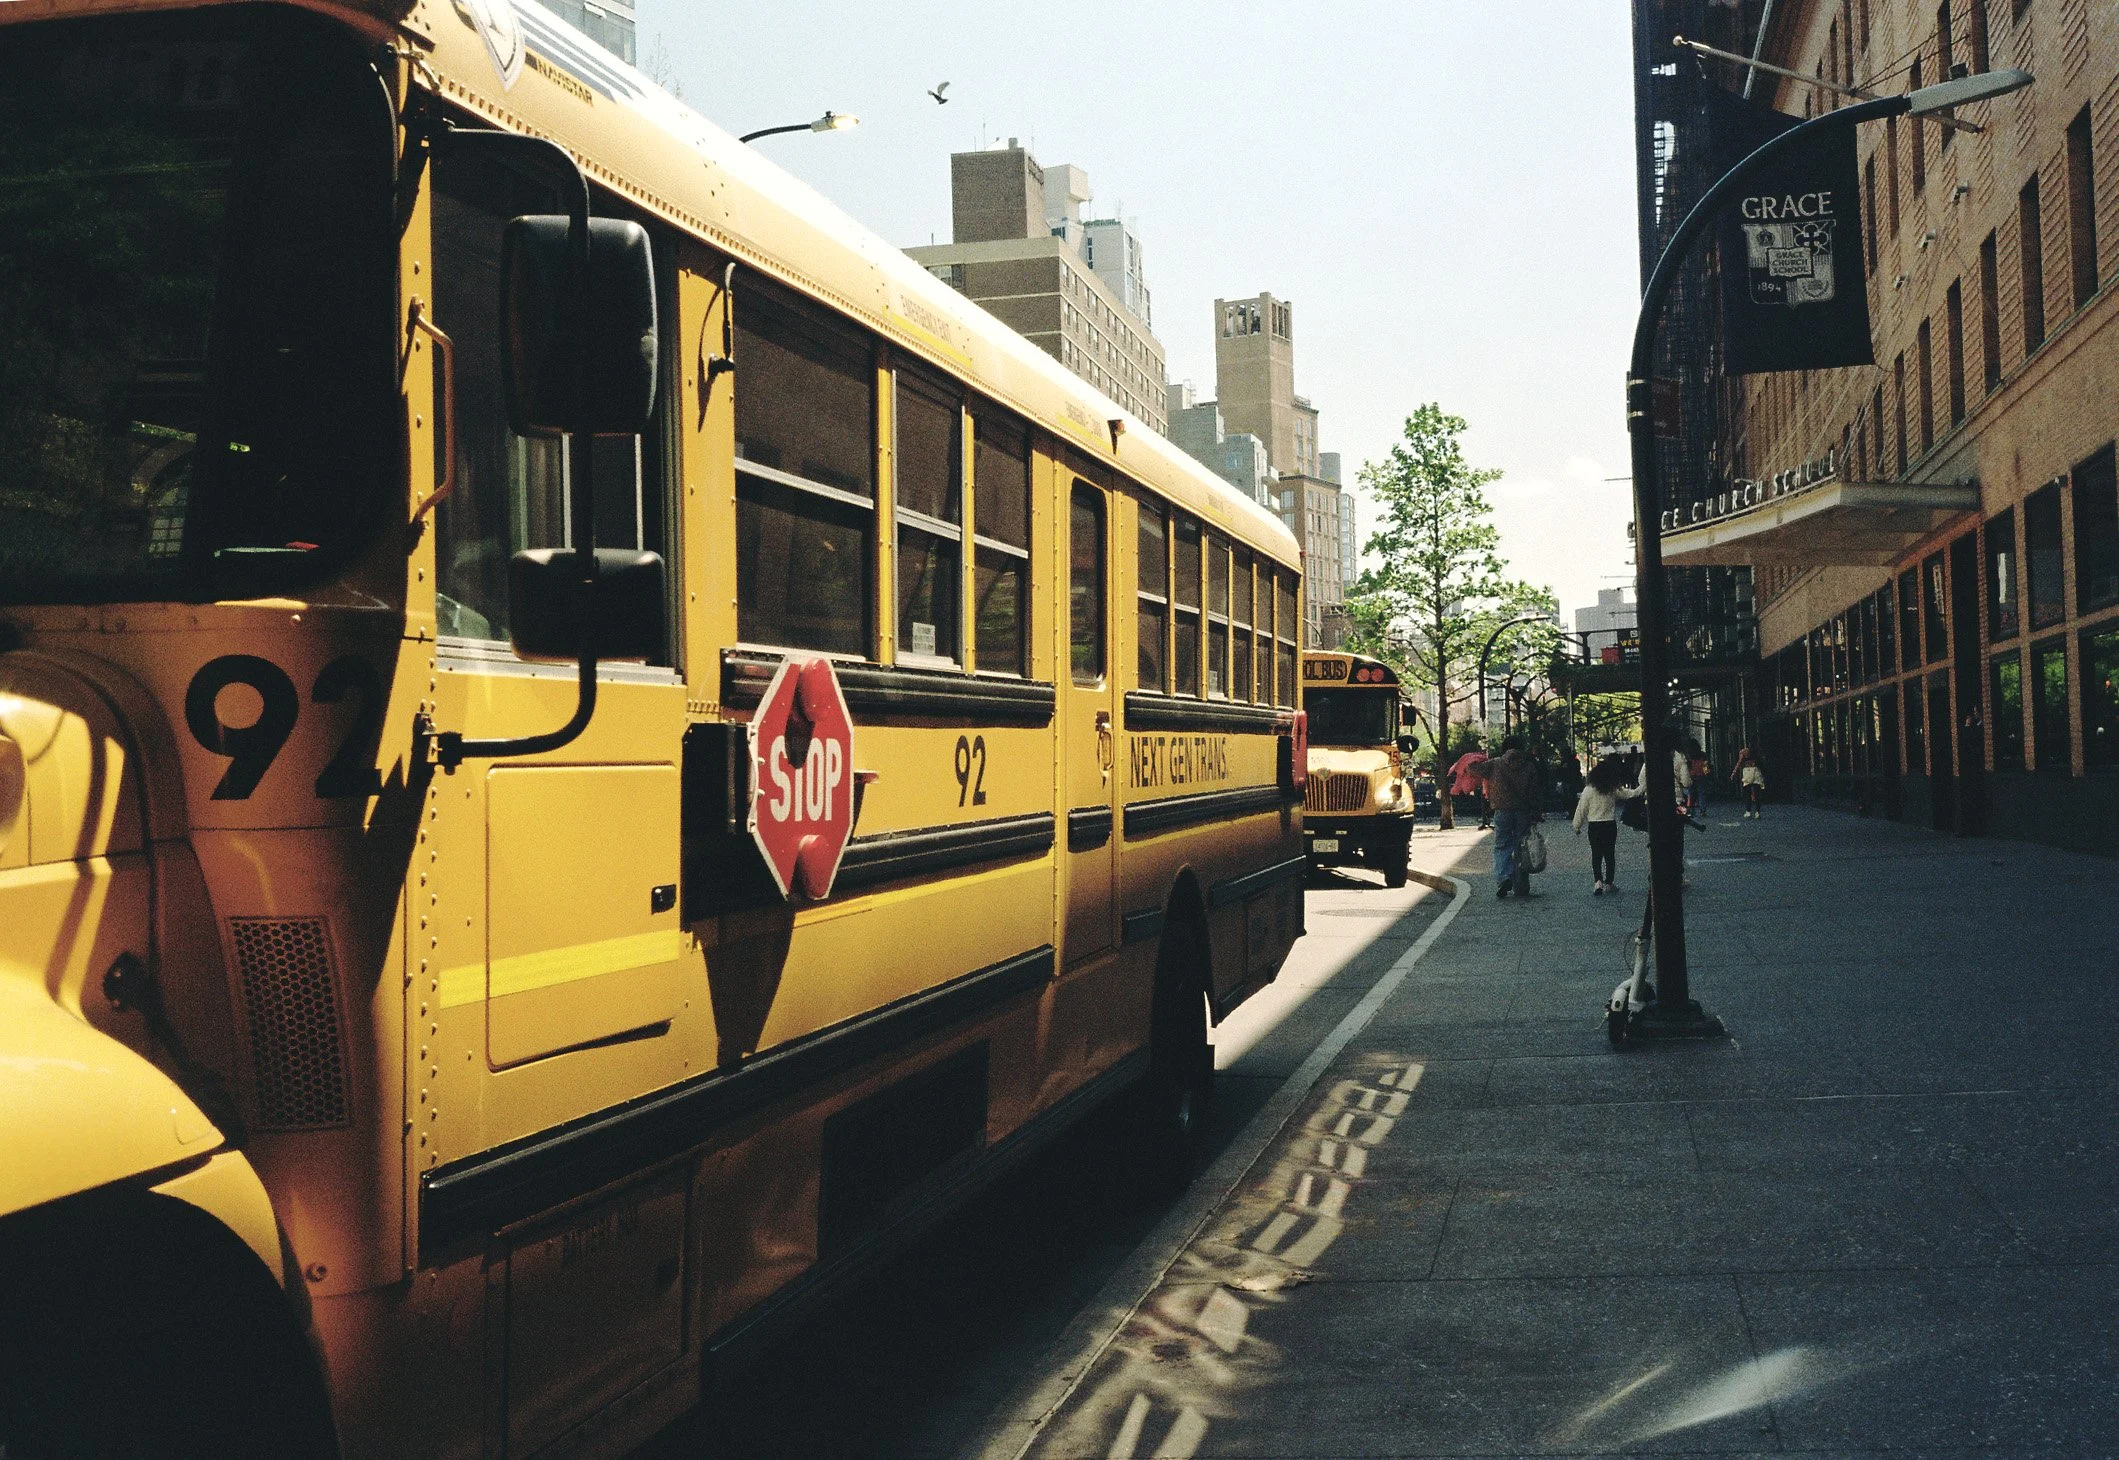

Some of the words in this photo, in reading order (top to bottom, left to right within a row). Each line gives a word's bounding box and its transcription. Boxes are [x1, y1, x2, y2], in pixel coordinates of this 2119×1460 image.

[1741, 192, 1833, 219] GRACE
[1772, 258, 1808, 266] CHURCH
[1775, 251, 1804, 259] GRACE
[1757, 281, 1781, 292] 1894
[1691, 480, 1763, 521] CHURCH
[1773, 449, 1834, 495] SCHOOL
[1322, 661, 1343, 679] BUS
[184, 654, 382, 800] 92
[955, 734, 987, 808] 92
[1130, 736, 1165, 788] NEXT
[1169, 737, 1193, 785] GEN
